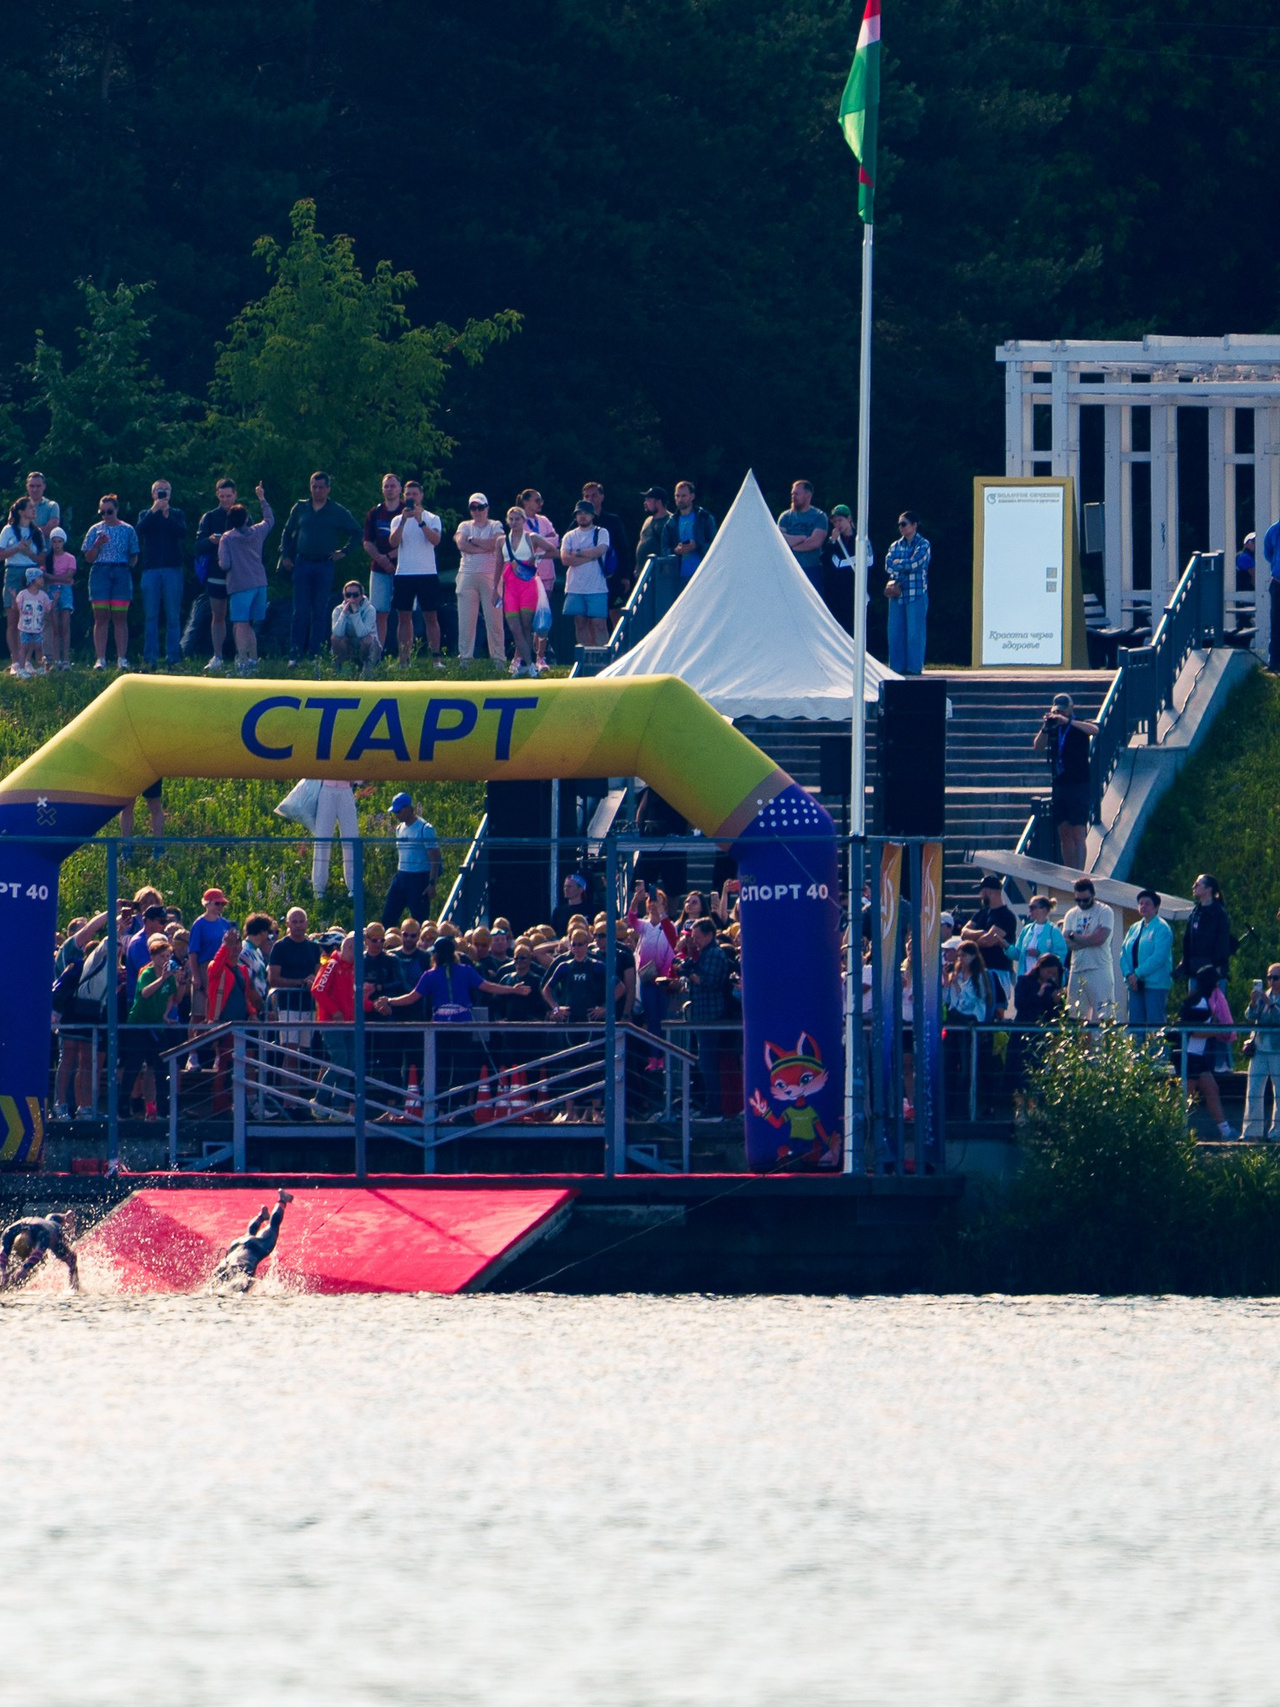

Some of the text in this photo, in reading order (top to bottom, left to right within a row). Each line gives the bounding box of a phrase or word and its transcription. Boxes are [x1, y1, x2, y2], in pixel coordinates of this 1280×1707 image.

[989, 630, 1054, 641] Красота через
[240, 695, 540, 762] СТАРТ
[25, 884, 49, 901] 40
[741, 883, 829, 902] СПОРТ 40
